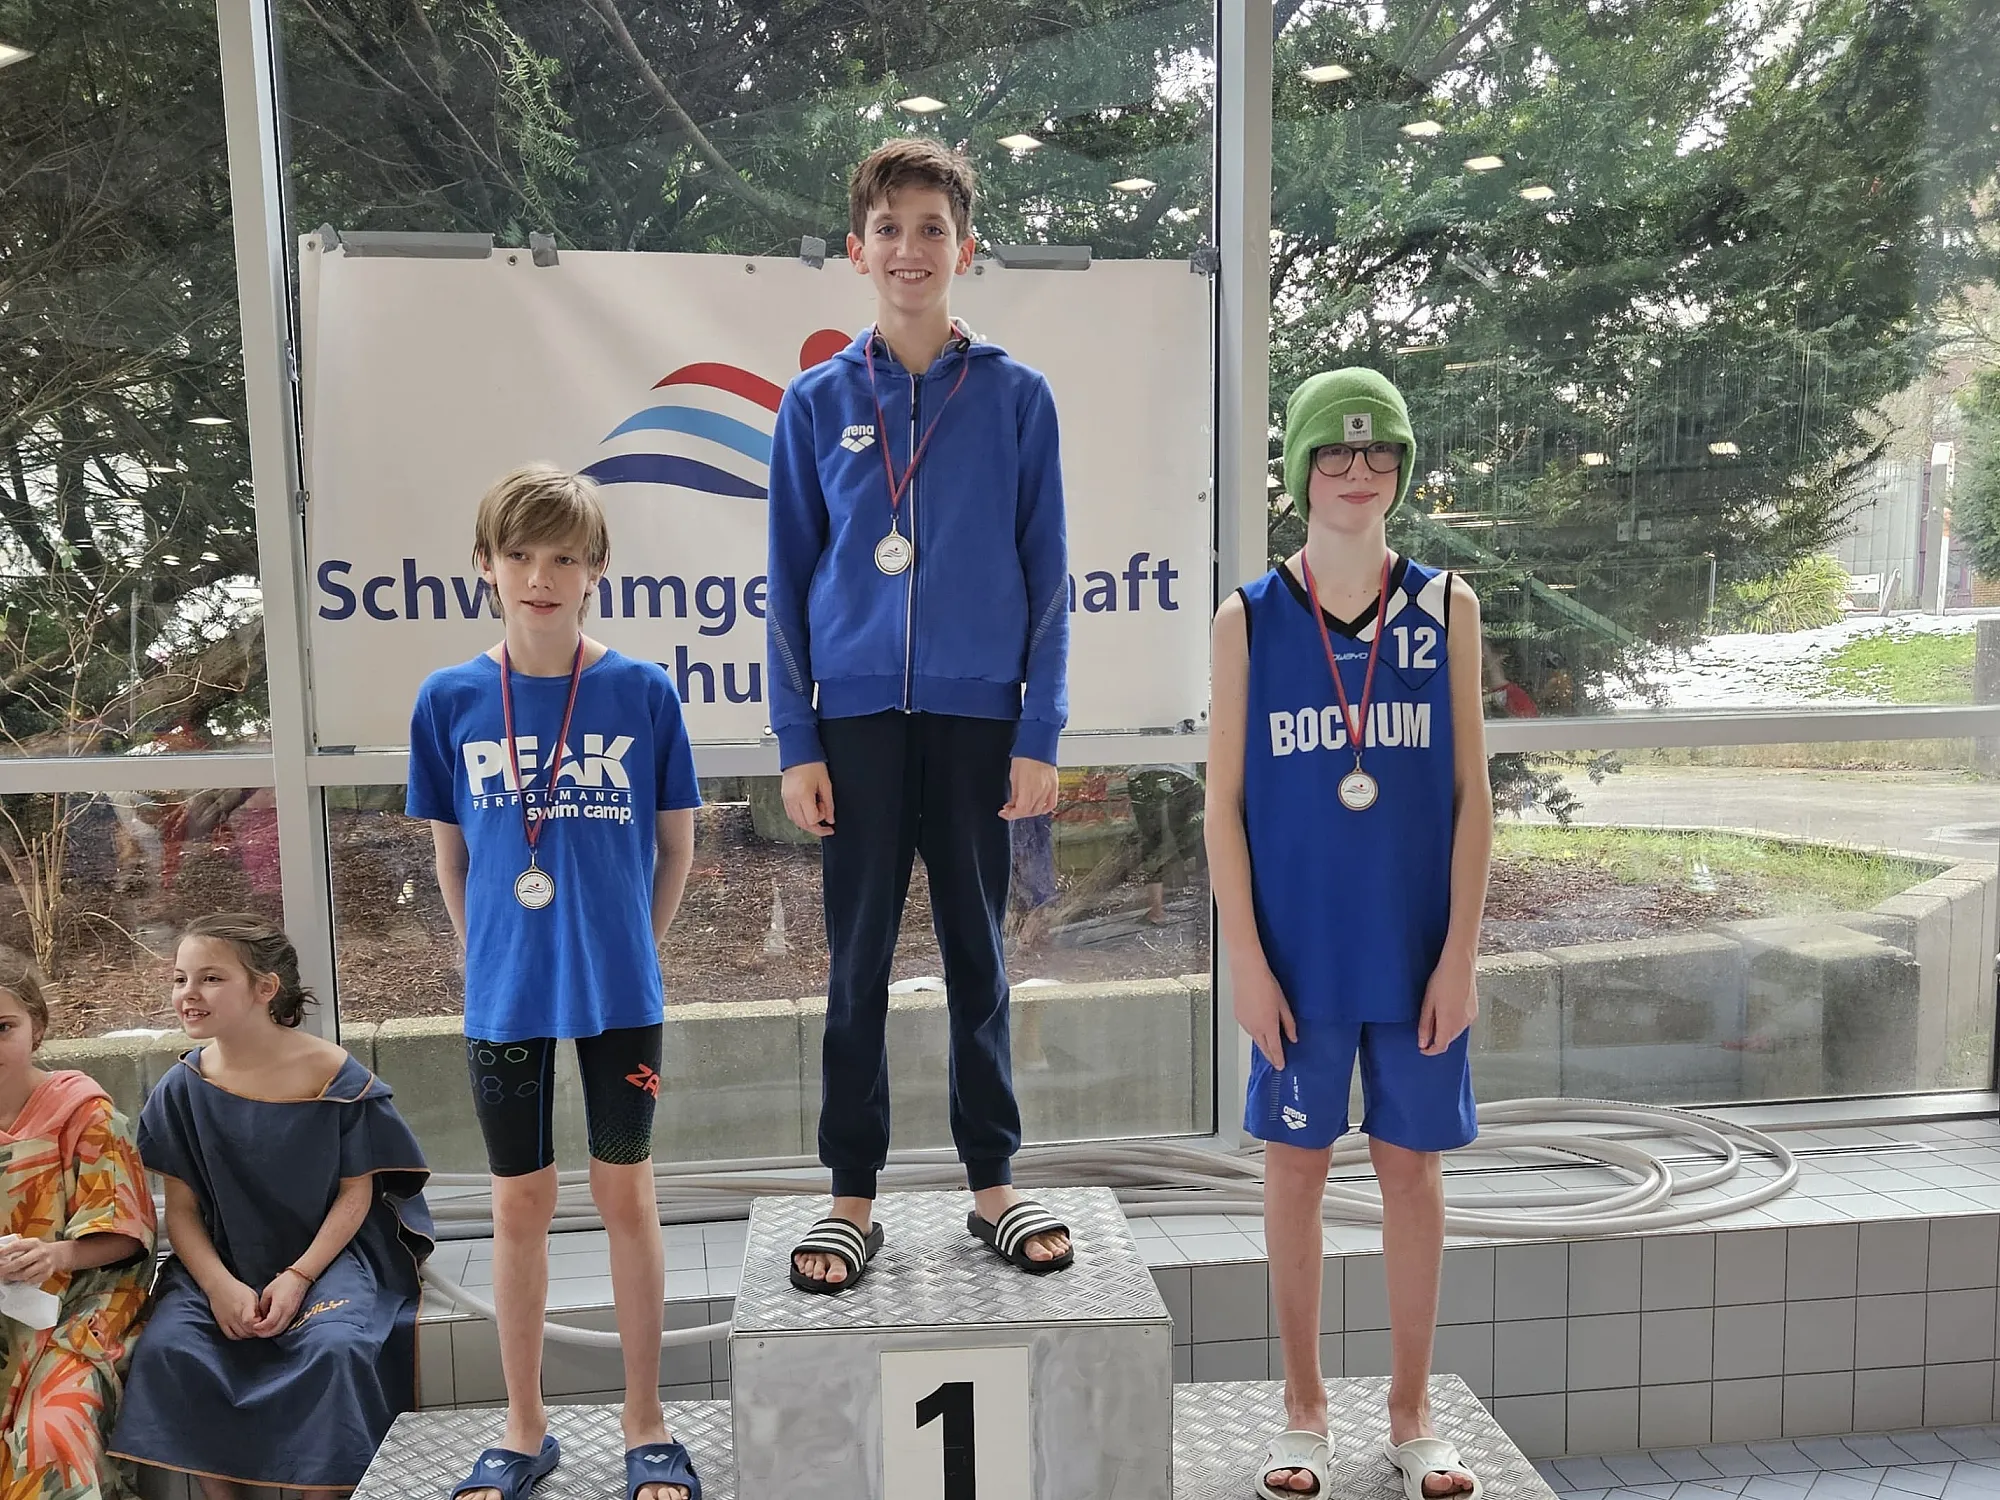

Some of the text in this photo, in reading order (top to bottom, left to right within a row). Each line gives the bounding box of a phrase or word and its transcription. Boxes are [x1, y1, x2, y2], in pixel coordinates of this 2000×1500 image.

[842, 424, 875, 439] arena
[1392, 626, 1437, 669] 12
[462, 734, 635, 796] PEAK
[526, 800, 579, 821] swim
[1283, 1105, 1308, 1122] arena
[915, 1381, 976, 1500] 1
